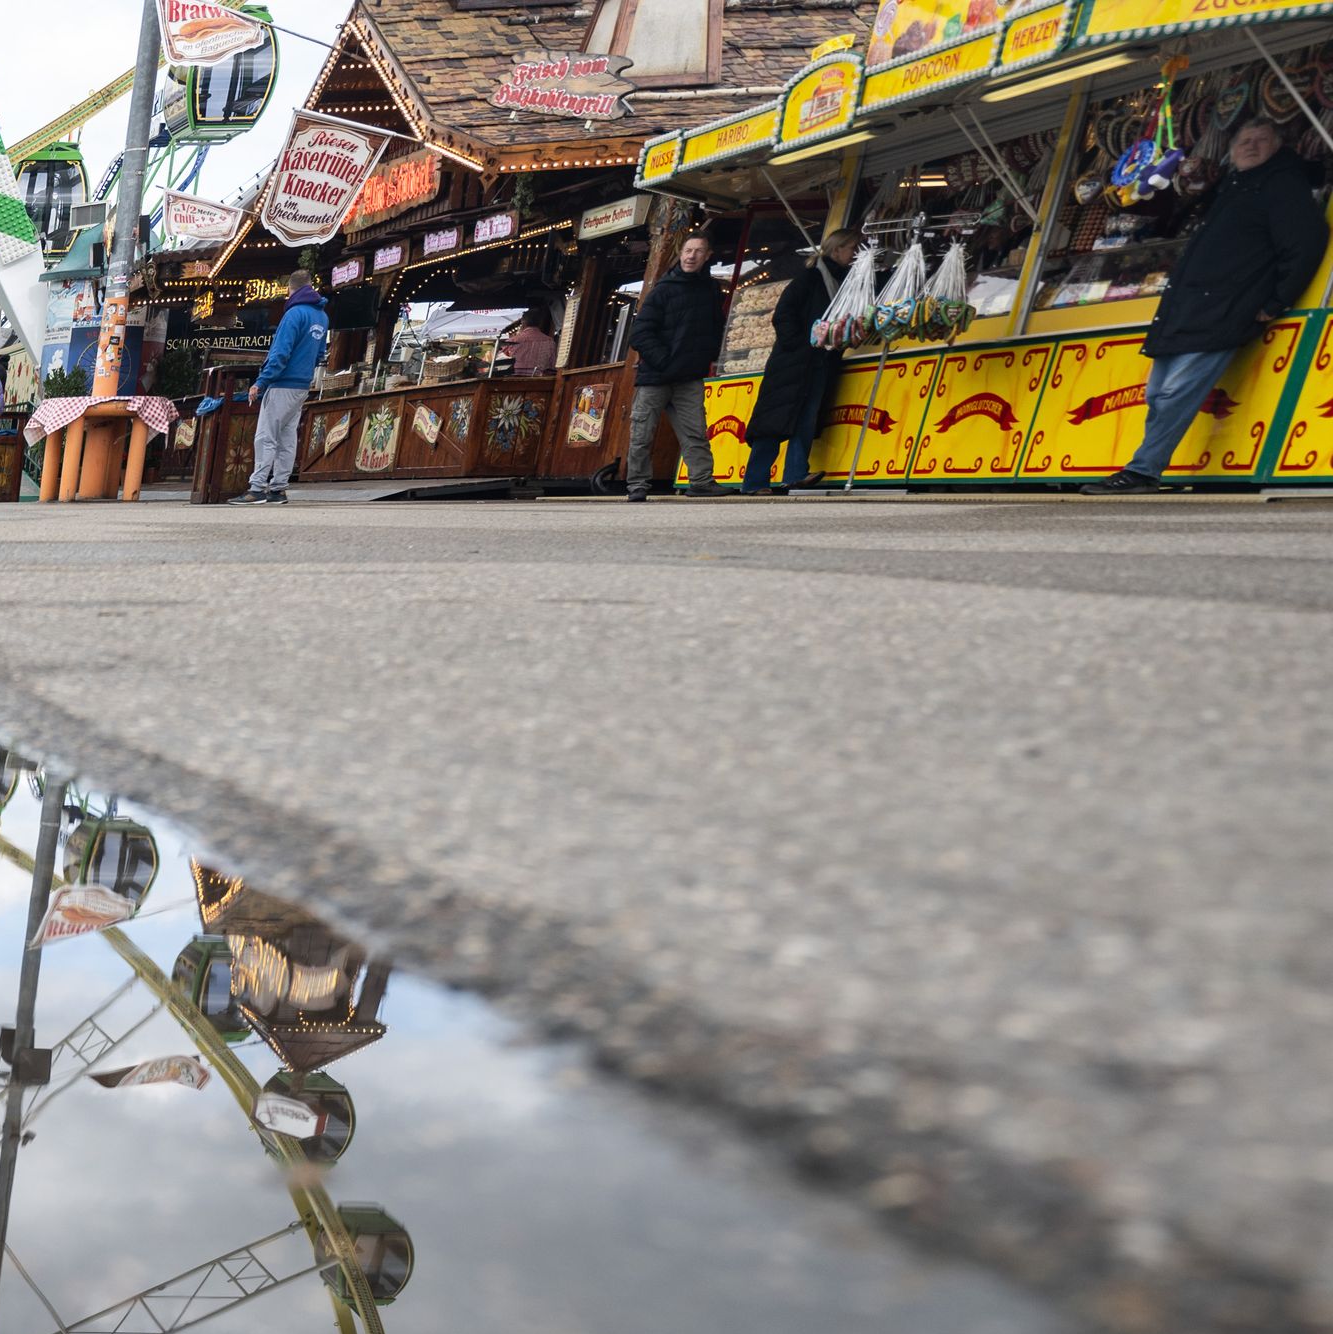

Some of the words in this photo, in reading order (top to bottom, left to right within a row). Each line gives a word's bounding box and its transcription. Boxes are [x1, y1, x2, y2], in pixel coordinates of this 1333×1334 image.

[169, 0, 236, 22] Bratw
[200, 36, 244, 54] Baguette
[1011, 18, 1061, 51] HERZEN
[513, 56, 570, 86] Frisch
[571, 58, 609, 78] vom
[902, 52, 961, 88] POPCORN
[495, 83, 618, 117] Holzkohlengrill
[308, 131, 360, 153] Riesen
[715, 124, 749, 149] HARIBO
[280, 147, 364, 187] Käsetrüffel-
[650, 150, 675, 171] NÜSSE
[283, 173, 347, 206] Knacker
[182, 203, 197, 215] 1/2
[198, 208, 218, 217] Meter
[269, 203, 339, 224] Speckmantel
[284, 196, 298, 210] im
[245, 279, 278, 303] Bier
[213, 335, 271, 348] AFFALTRACH
[1102, 386, 1147, 413] MANDE
